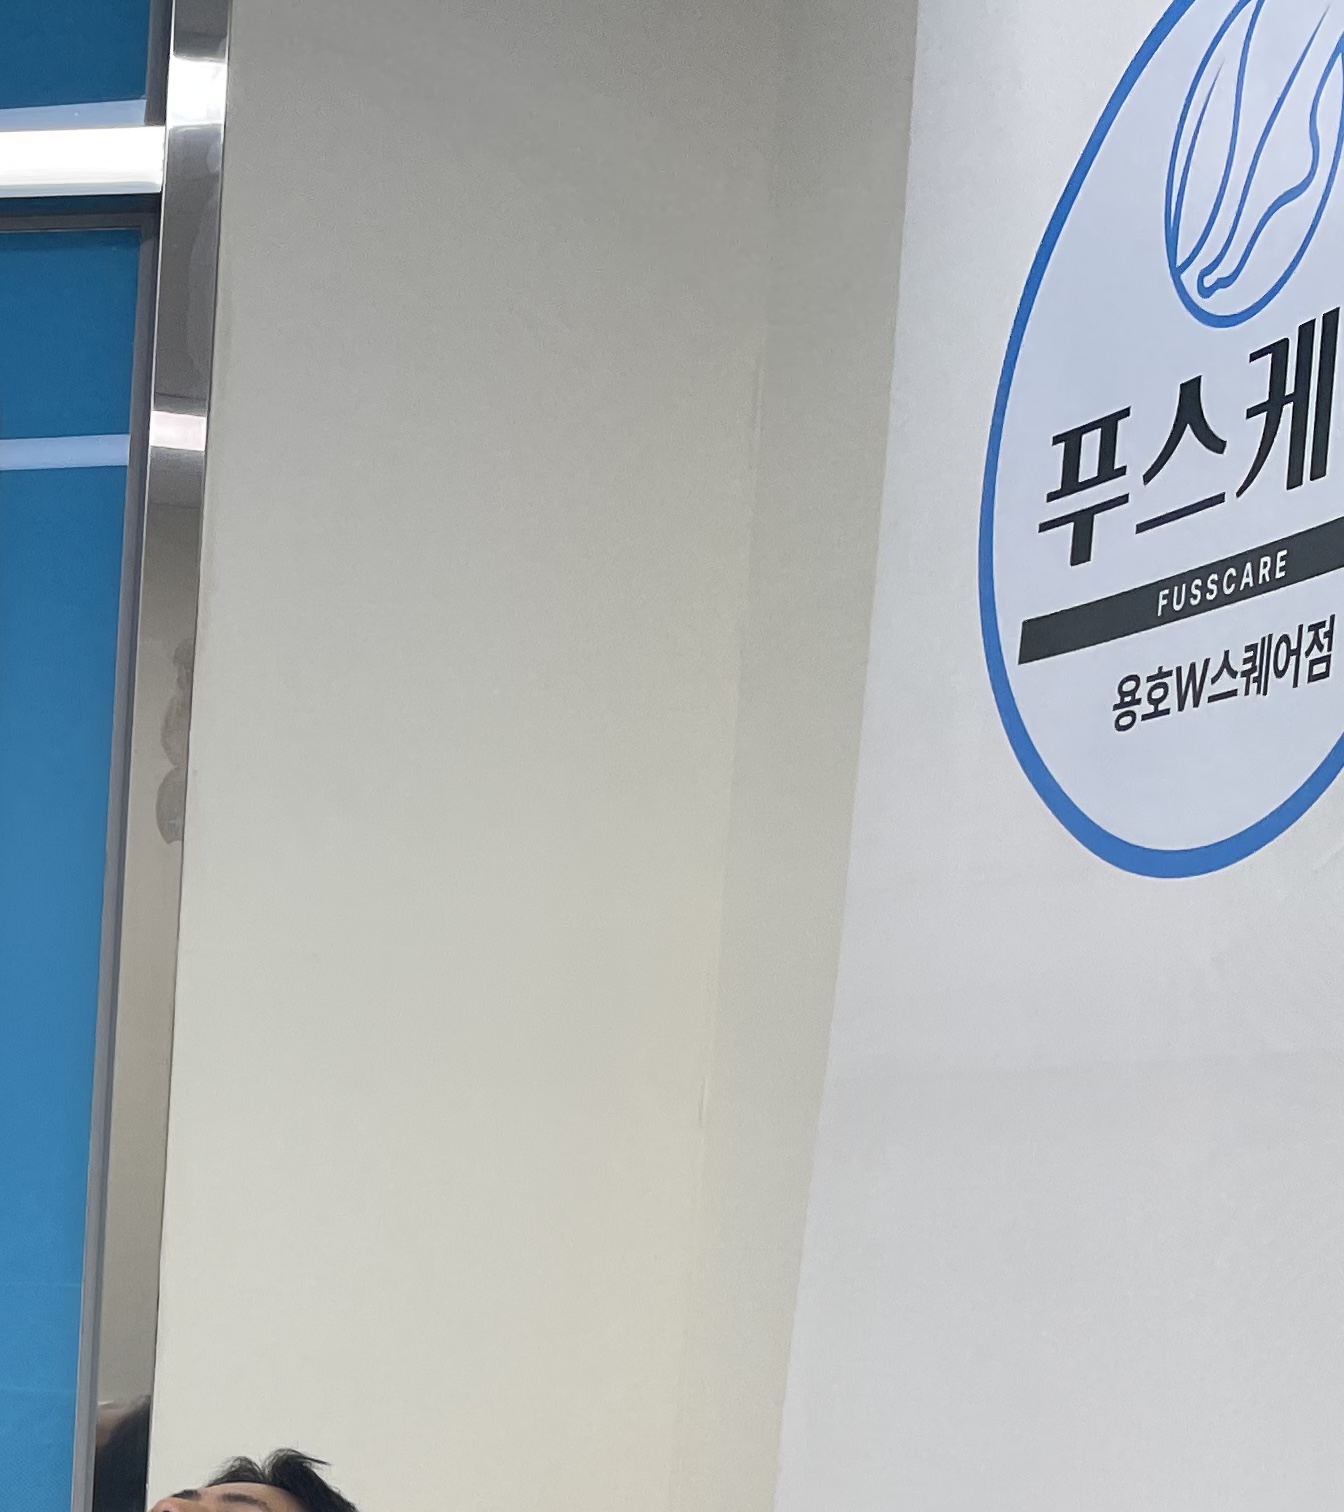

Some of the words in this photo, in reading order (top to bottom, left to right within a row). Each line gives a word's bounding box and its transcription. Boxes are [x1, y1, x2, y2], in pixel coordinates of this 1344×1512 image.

[1038, 306, 1340, 567] 푸스케
[1156, 548, 1289, 618] FUSSCARE
[1112, 613, 1336, 732] 용호W스퀘어점
